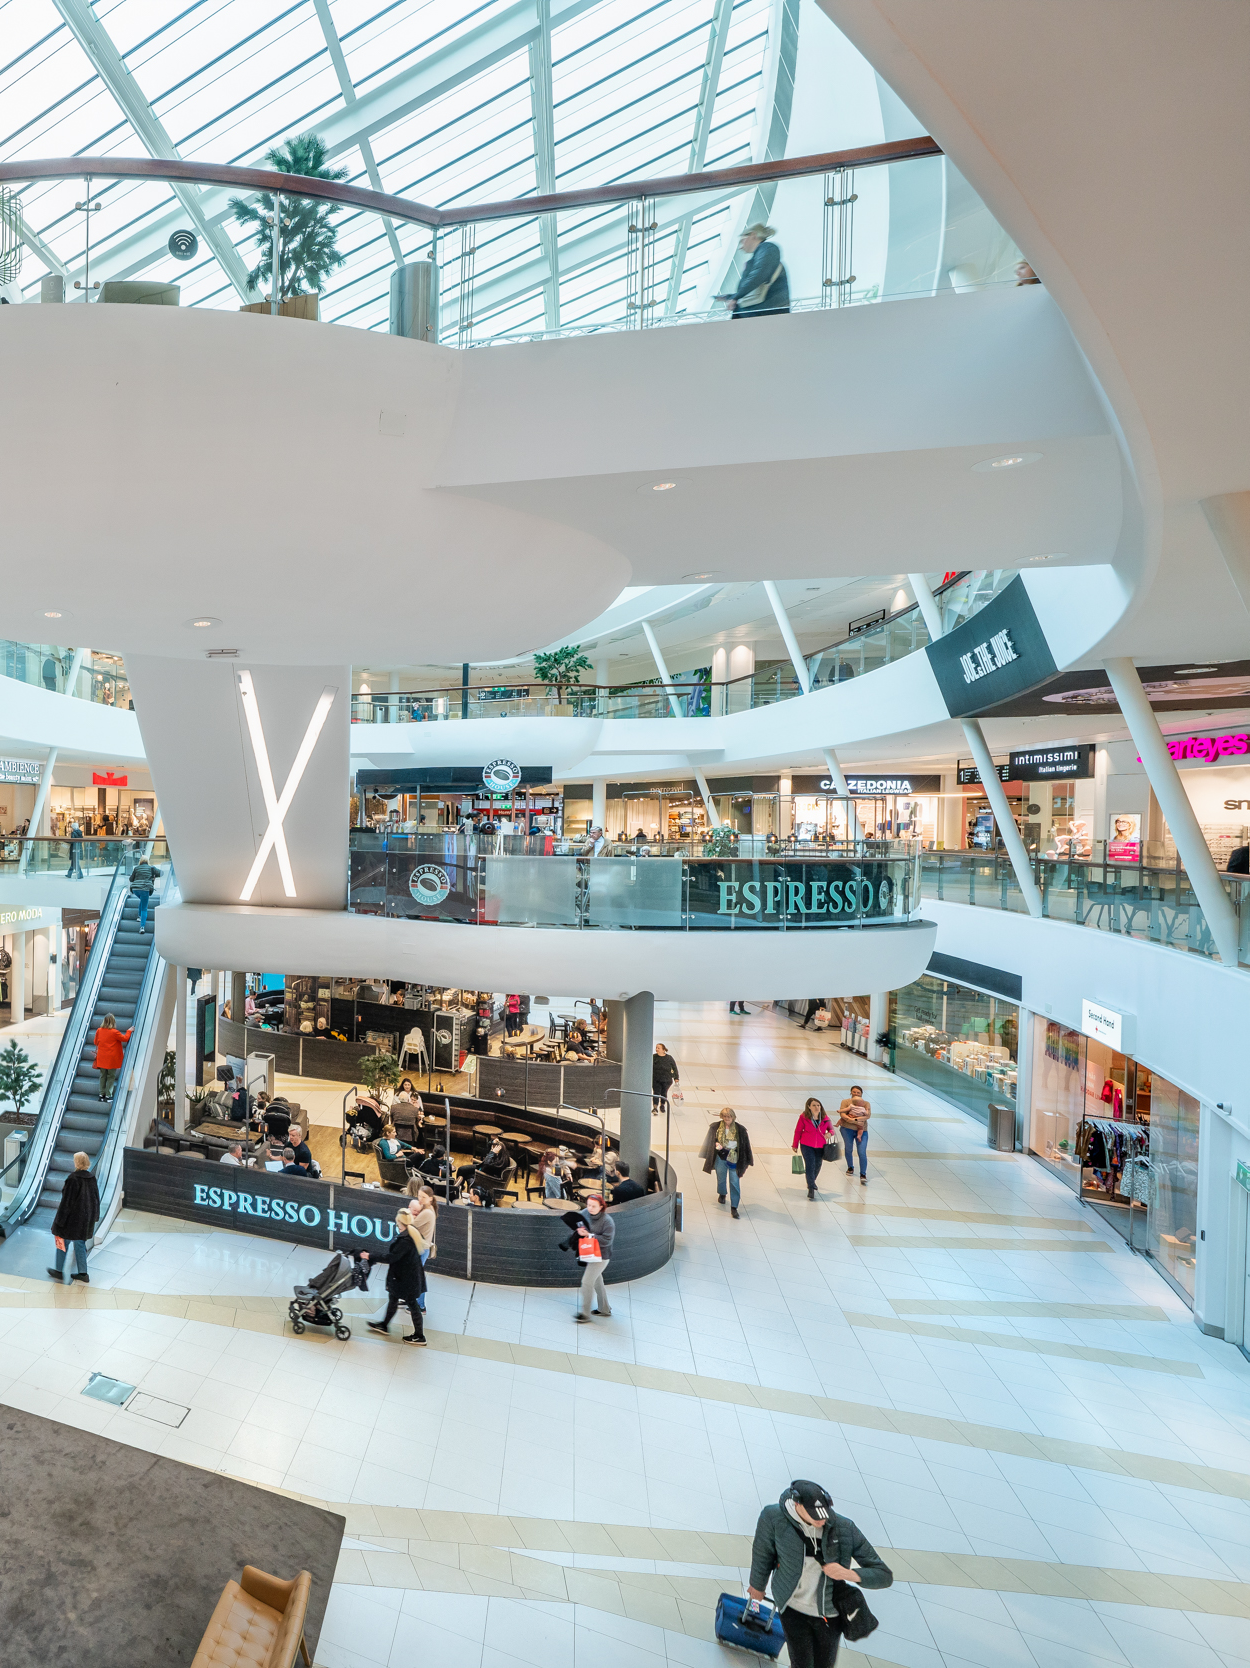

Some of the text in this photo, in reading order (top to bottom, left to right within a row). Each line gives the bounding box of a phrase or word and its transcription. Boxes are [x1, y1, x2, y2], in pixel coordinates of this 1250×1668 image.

[960, 652, 980, 684] JOE
[974, 642, 997, 675] THE
[990, 628, 1018, 668] JUICE
[1136, 733, 1249, 763] arteyes
[1015, 751, 1078, 765] intimissimi
[485, 759, 518, 773] ESPRESSO
[489, 781, 515, 791] HOUSE
[820, 780, 911, 790] CAZEDONIA
[412, 867, 447, 883] ESPRESSO
[415, 892, 442, 902] HOUSE
[717, 880, 874, 914] ESPRESSO
[18, 908, 43, 921] MODA
[1088, 1009, 1115, 1029] Second Hand
[194, 1184, 402, 1242] ESPRESSO HOU
